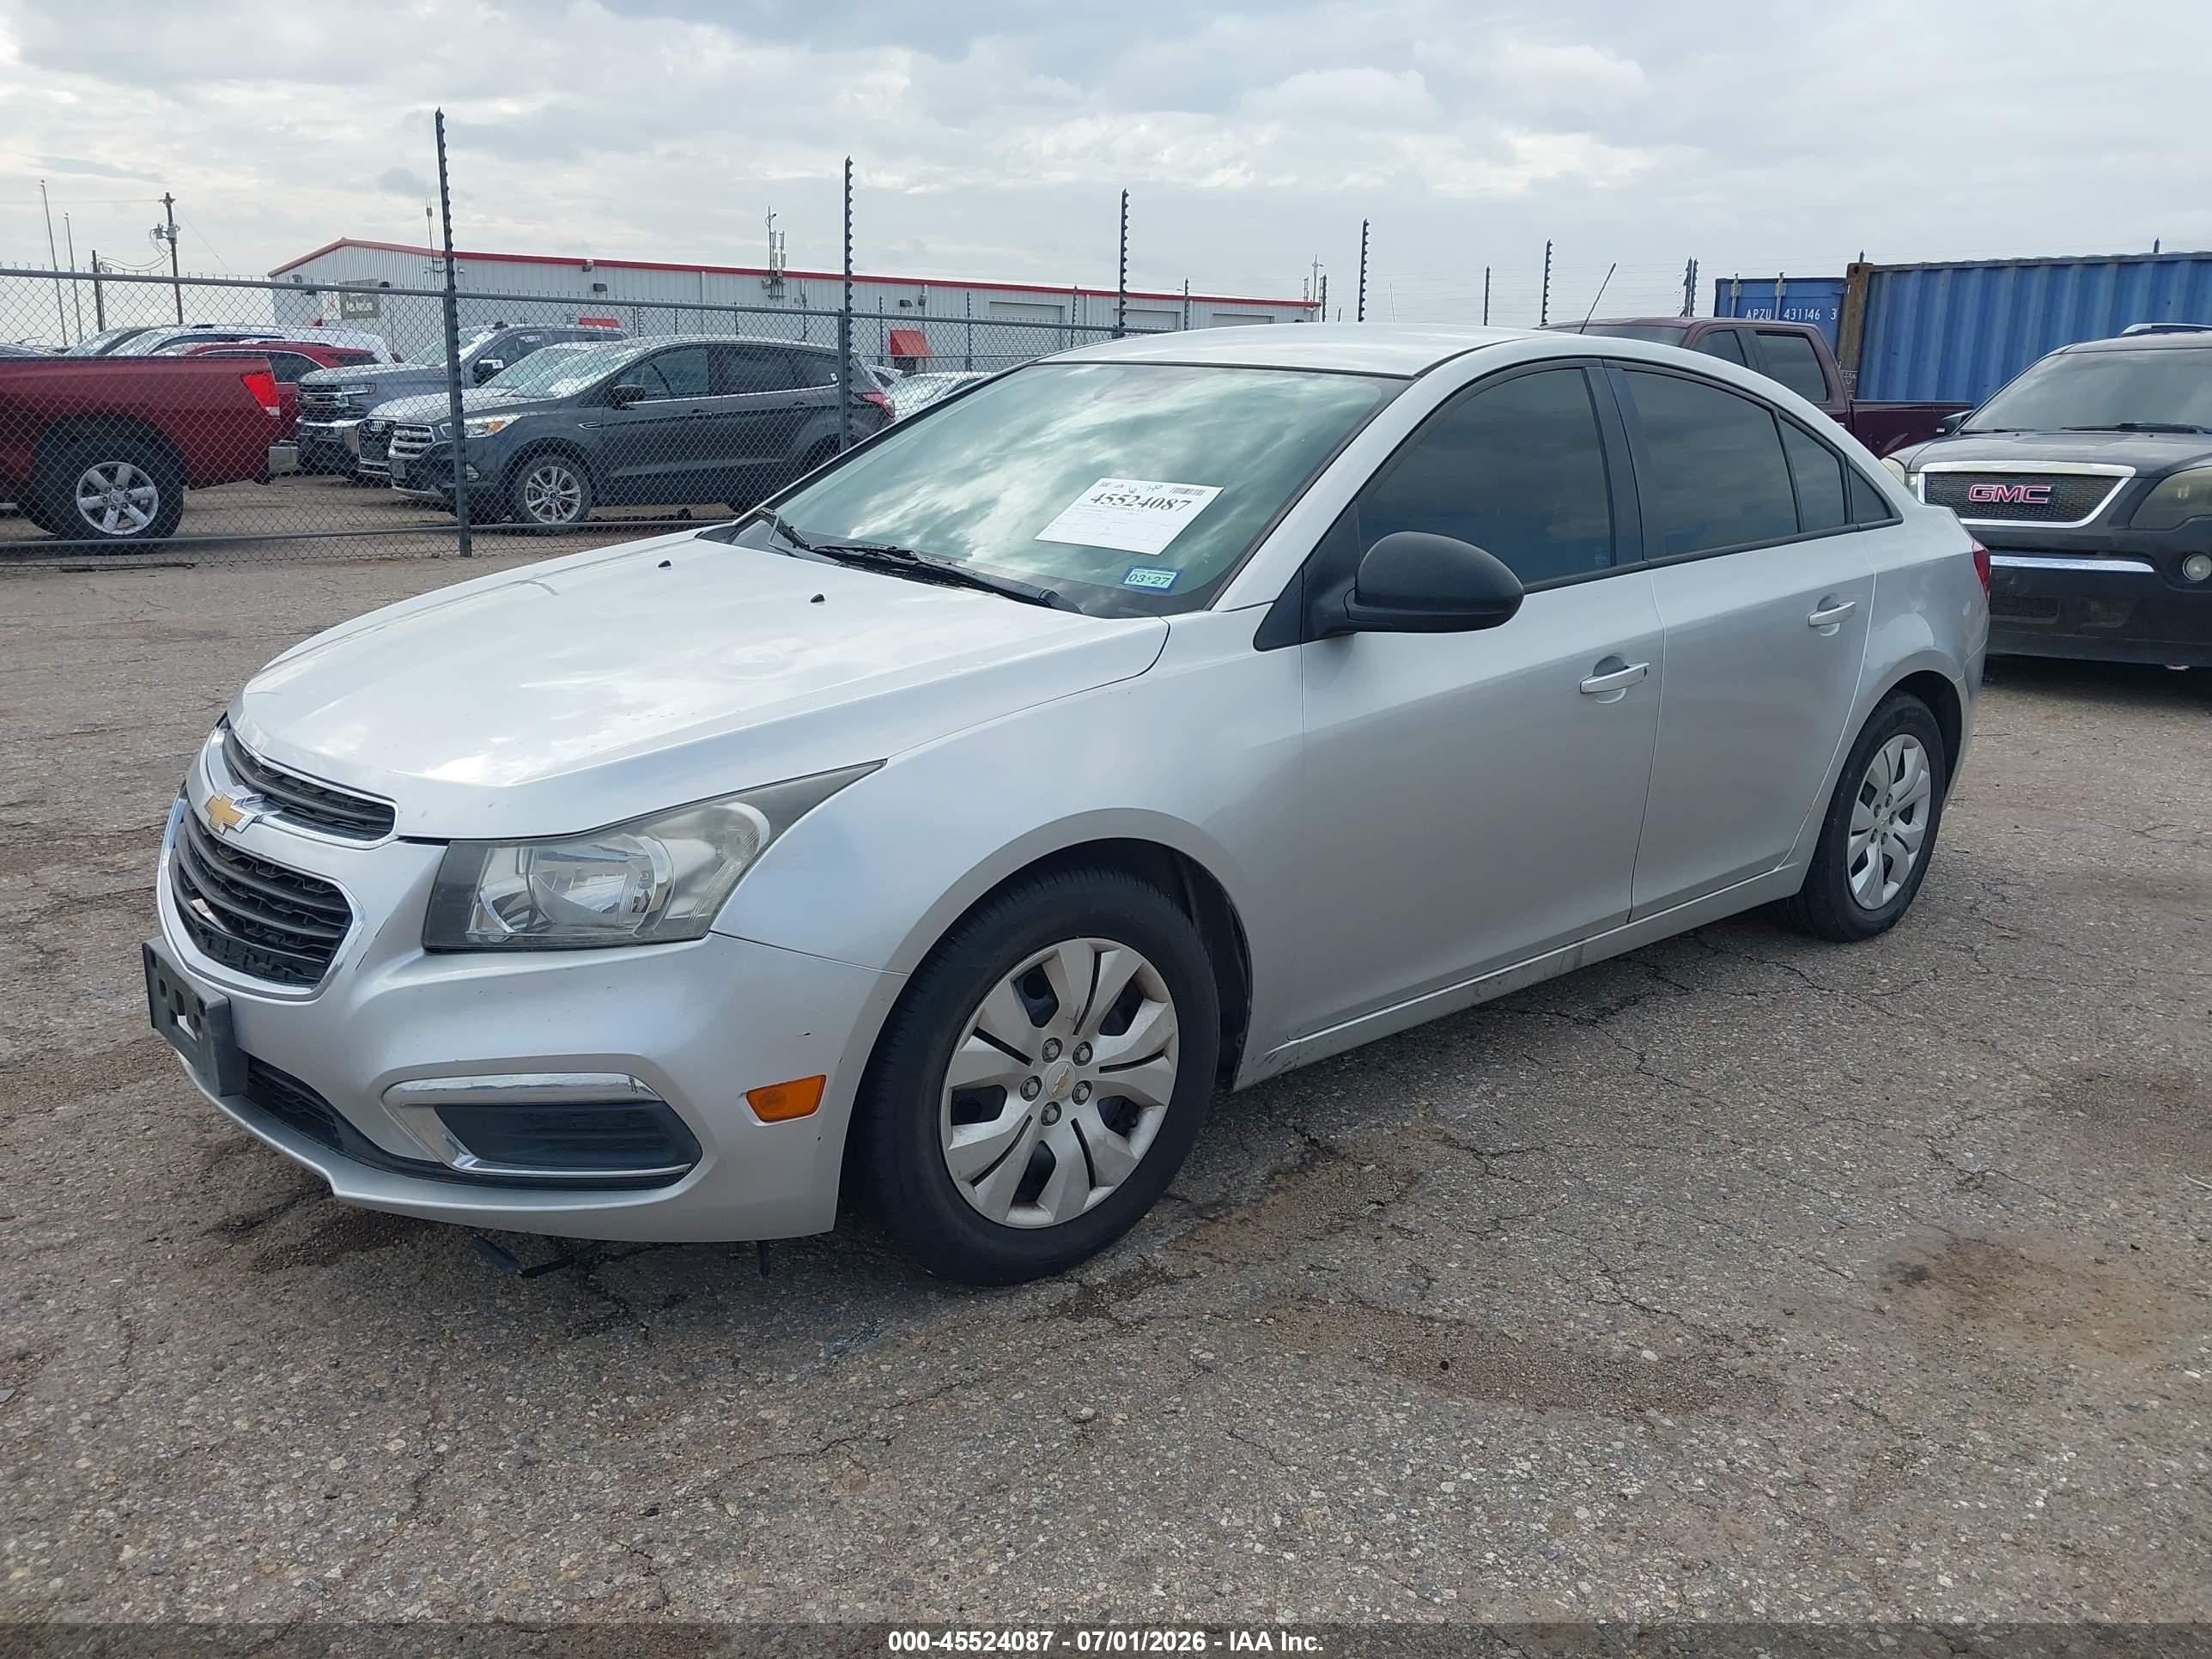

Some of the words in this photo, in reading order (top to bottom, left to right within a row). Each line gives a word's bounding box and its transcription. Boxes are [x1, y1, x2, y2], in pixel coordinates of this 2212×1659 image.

[1746, 308, 1771, 320] APZU
[1784, 308, 1820, 320] 431146
[1830, 308, 1838, 320] 3
[1090, 492, 1194, 512] 45524087
[1968, 484, 2051, 503] GMC
